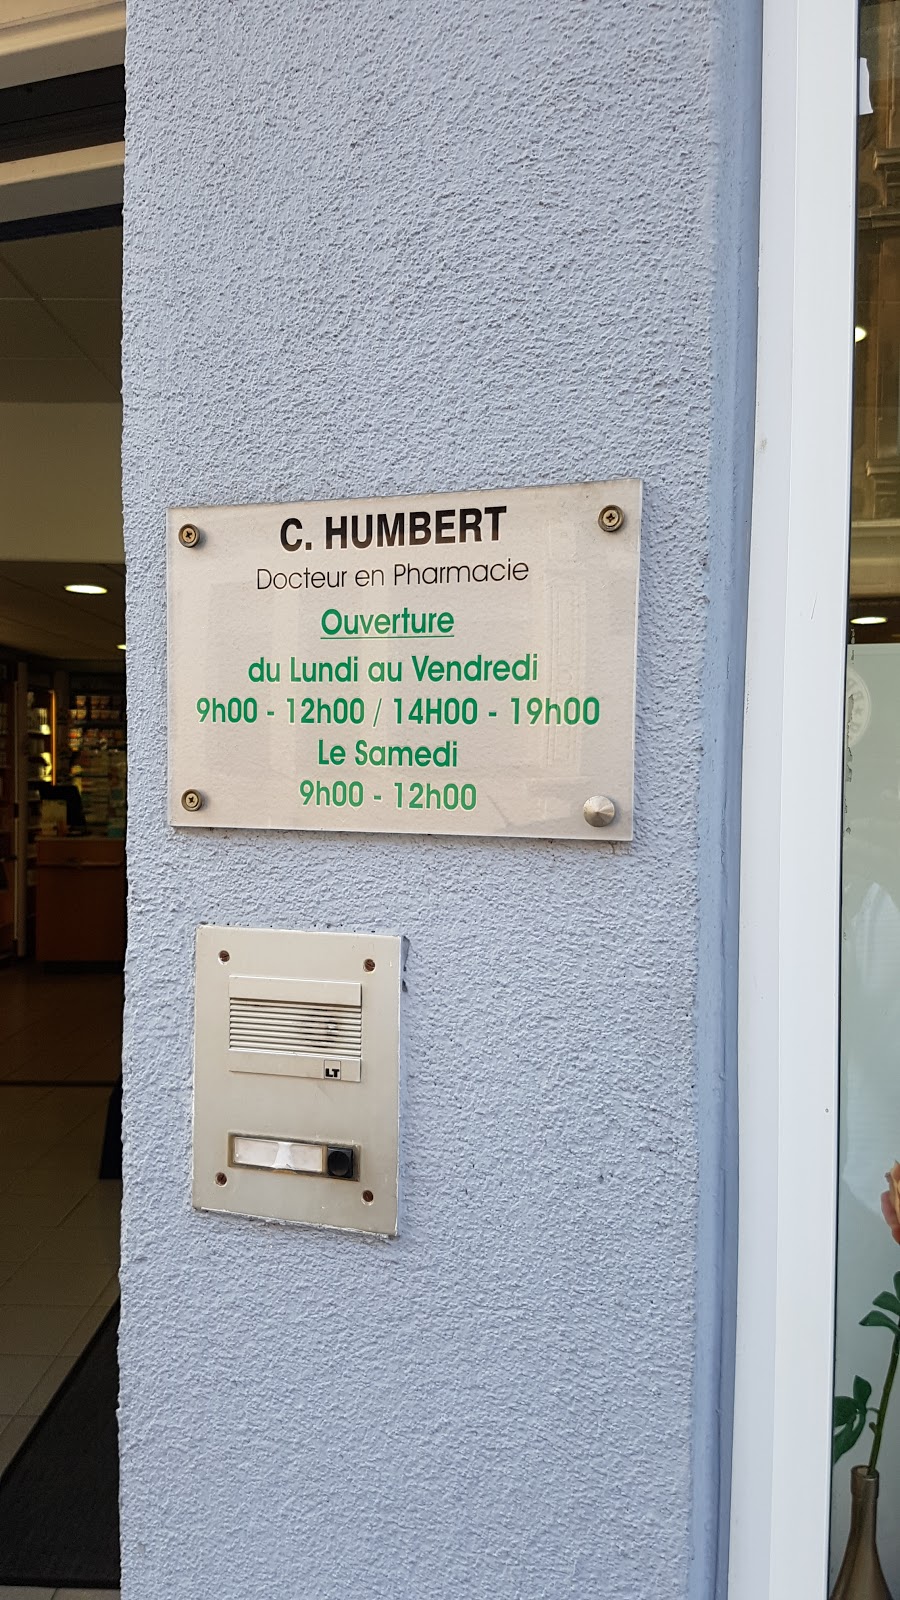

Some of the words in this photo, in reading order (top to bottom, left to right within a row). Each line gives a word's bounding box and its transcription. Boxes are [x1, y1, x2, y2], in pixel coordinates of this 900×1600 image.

[281, 518, 311, 551] C.
[326, 506, 507, 549] HUMBERT
[258, 568, 347, 589] Docteur
[355, 570, 383, 586] en
[395, 558, 528, 585] Pharmacie
[321, 608, 454, 634] Ouverture
[248, 657, 280, 683] du
[290, 656, 358, 683] Lundi
[368, 662, 402, 682] au
[411, 654, 537, 682] Vendredi
[197, 697, 258, 723] 9h00
[288, 698, 364, 725] 12h00
[372, 698, 382, 727] /
[394, 697, 478, 725] 14H00
[512, 696, 600, 725] 19h00
[318, 739, 346, 765] Le
[355, 740, 457, 767] Samedi
[300, 780, 363, 807] 9h00
[394, 782, 476, 810] 12h00
[325, 1068, 340, 1078] LT
